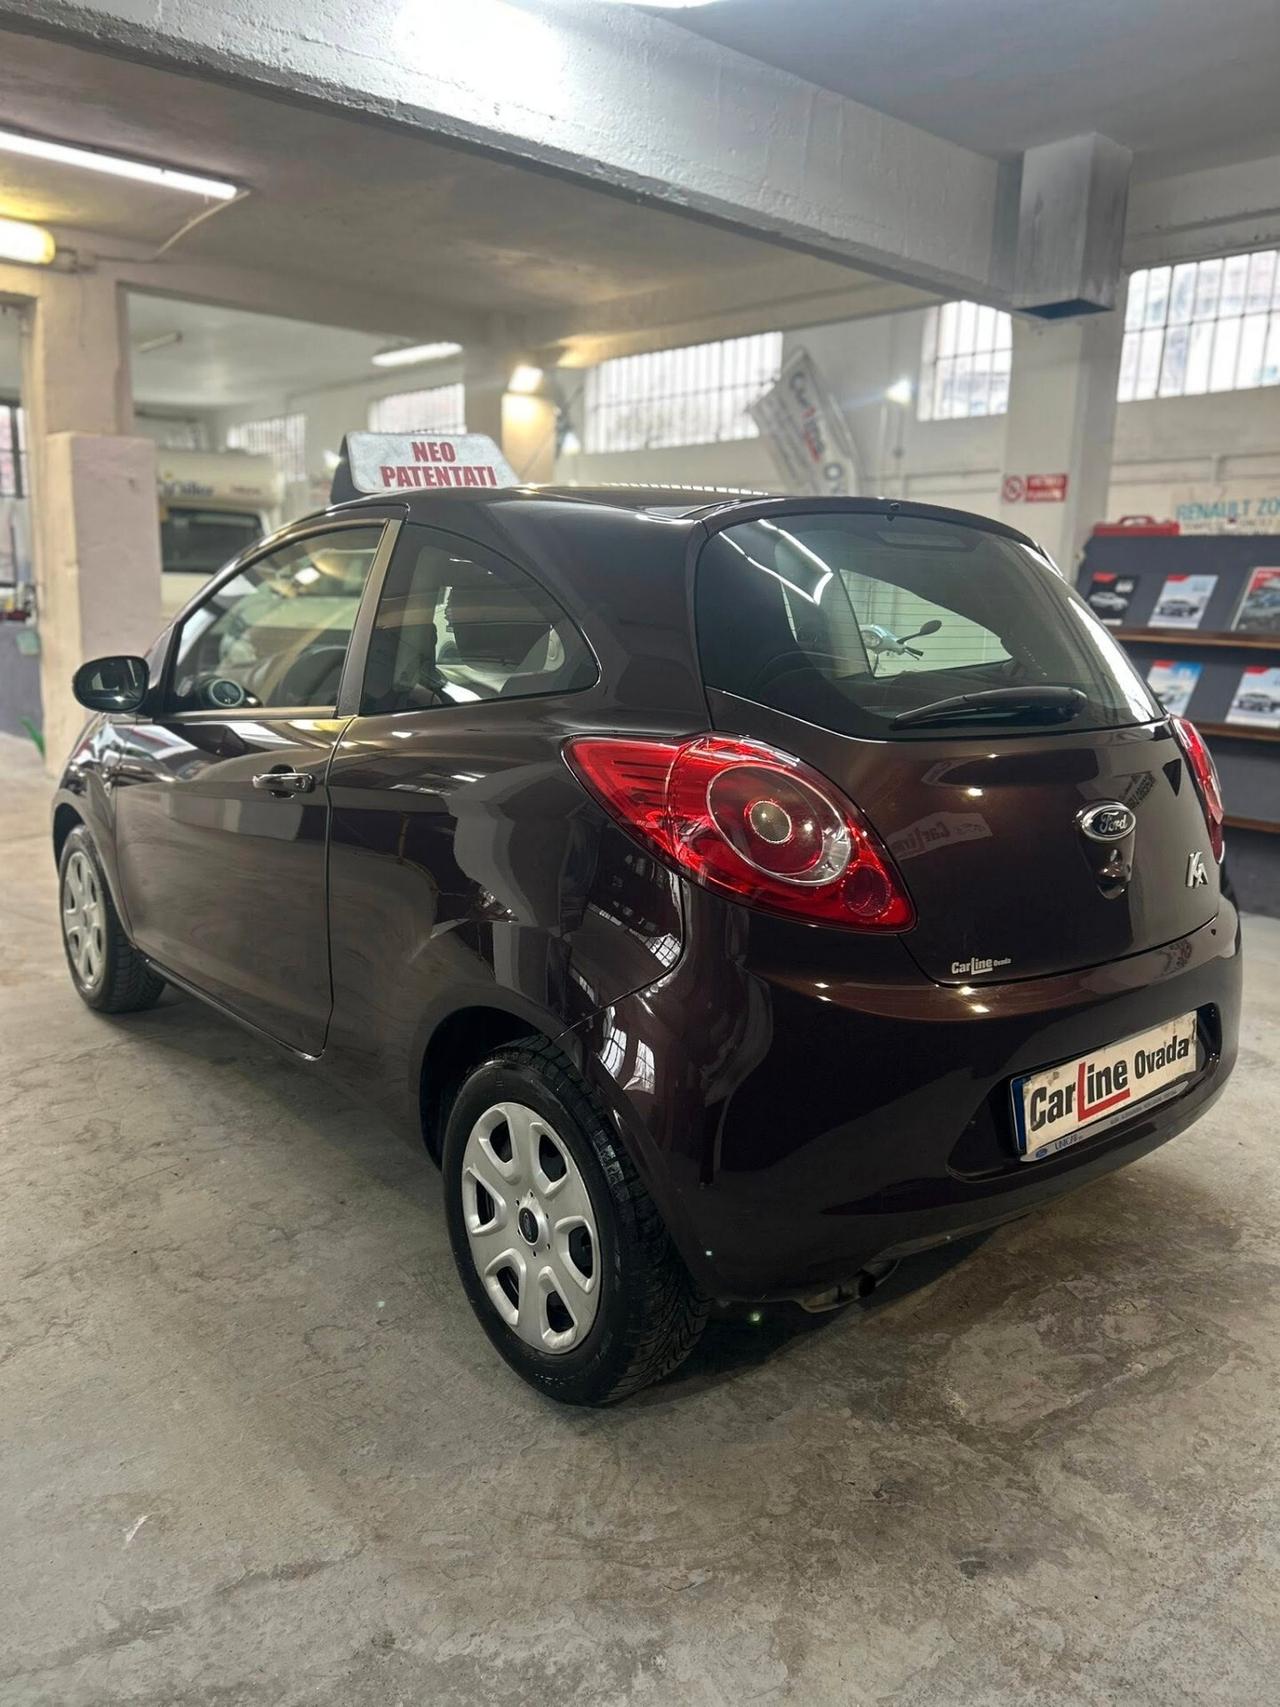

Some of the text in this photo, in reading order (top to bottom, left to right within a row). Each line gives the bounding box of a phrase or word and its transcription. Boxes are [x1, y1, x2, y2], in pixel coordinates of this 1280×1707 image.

[411, 441, 456, 462] NEO
[380, 466, 497, 487] PATENTATI
[1100, 811, 1128, 834] Ford
[1134, 1036, 1190, 1080] Ovada
